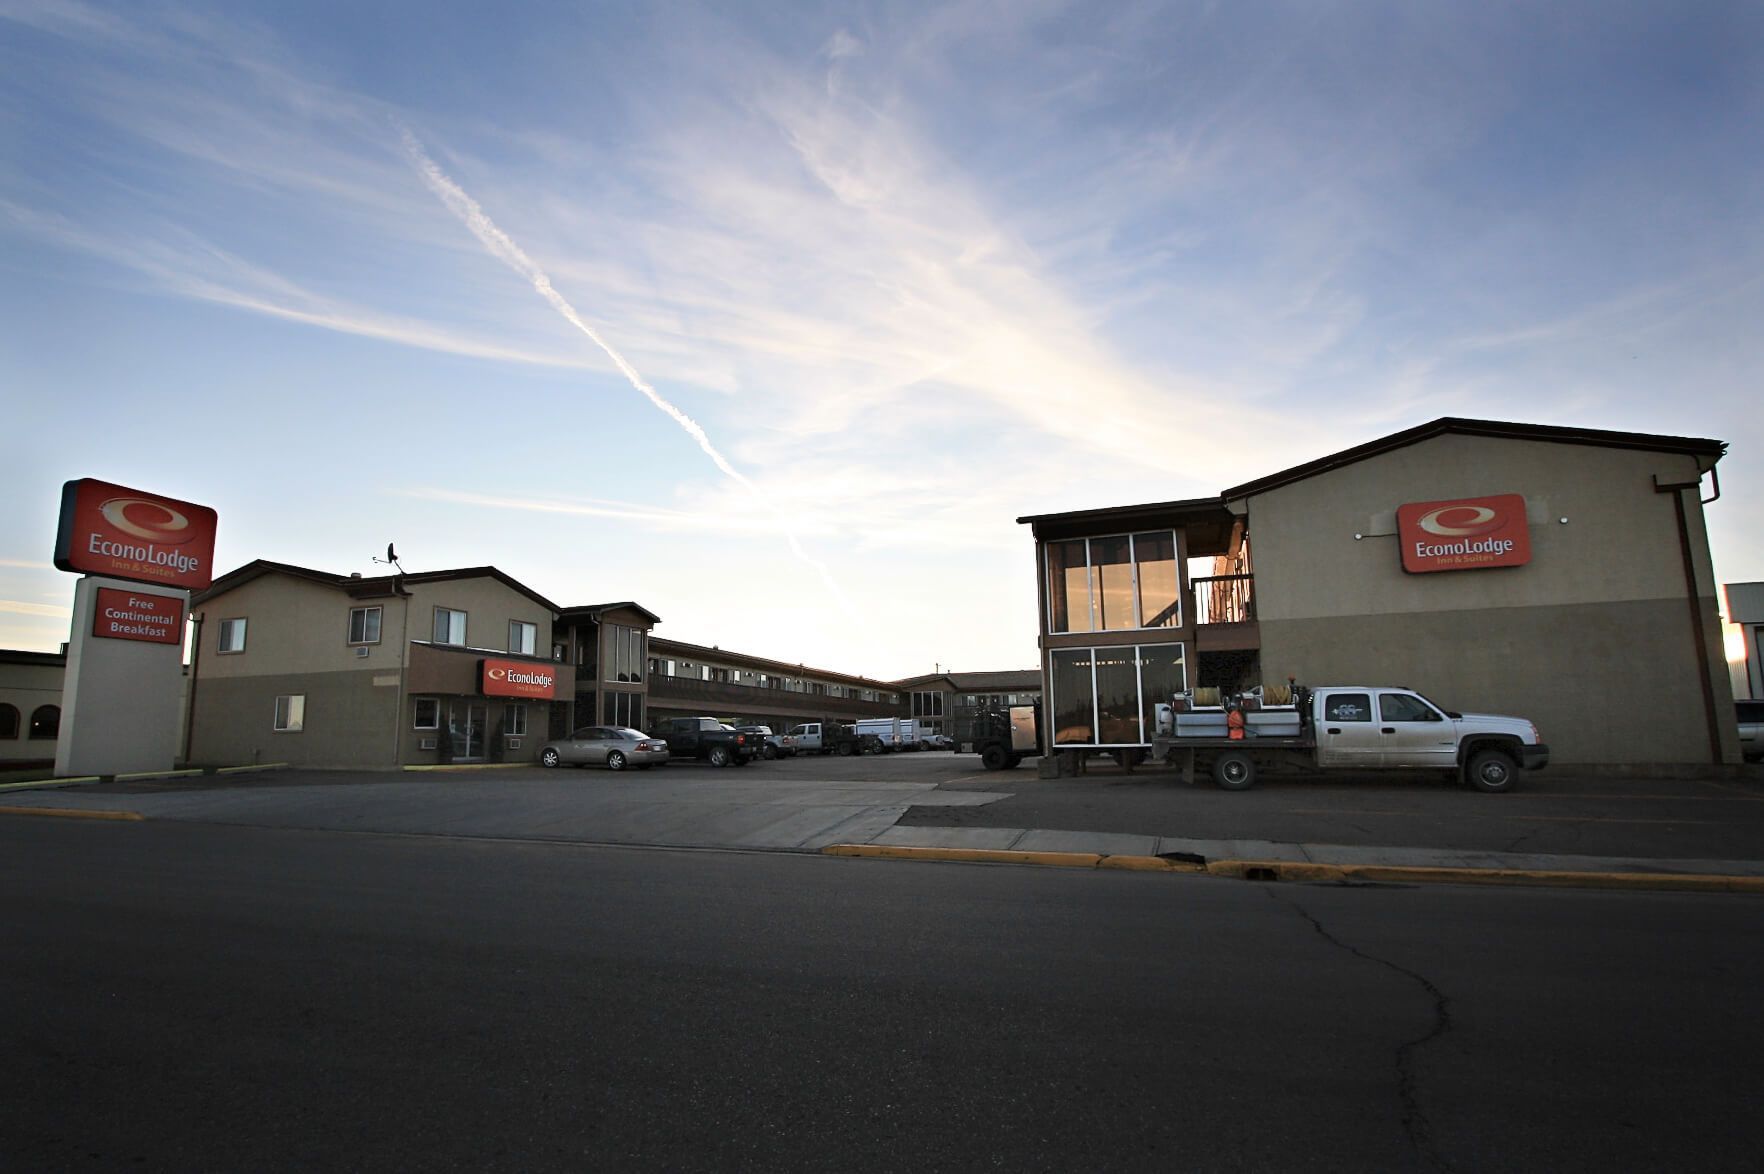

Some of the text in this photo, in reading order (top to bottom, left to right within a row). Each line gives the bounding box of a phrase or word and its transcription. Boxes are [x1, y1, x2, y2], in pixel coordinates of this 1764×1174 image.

[89, 533, 198, 573] EconoLodge
[1416, 537, 1513, 557] EconoLodge
[111, 559, 175, 578] Inn & Suites
[1437, 554, 1494, 565] Inn & Suites
[128, 597, 154, 610] Free
[105, 607, 173, 625] Continental
[110, 621, 166, 637] Breakfast
[507, 669, 552, 688] EconoLodge
